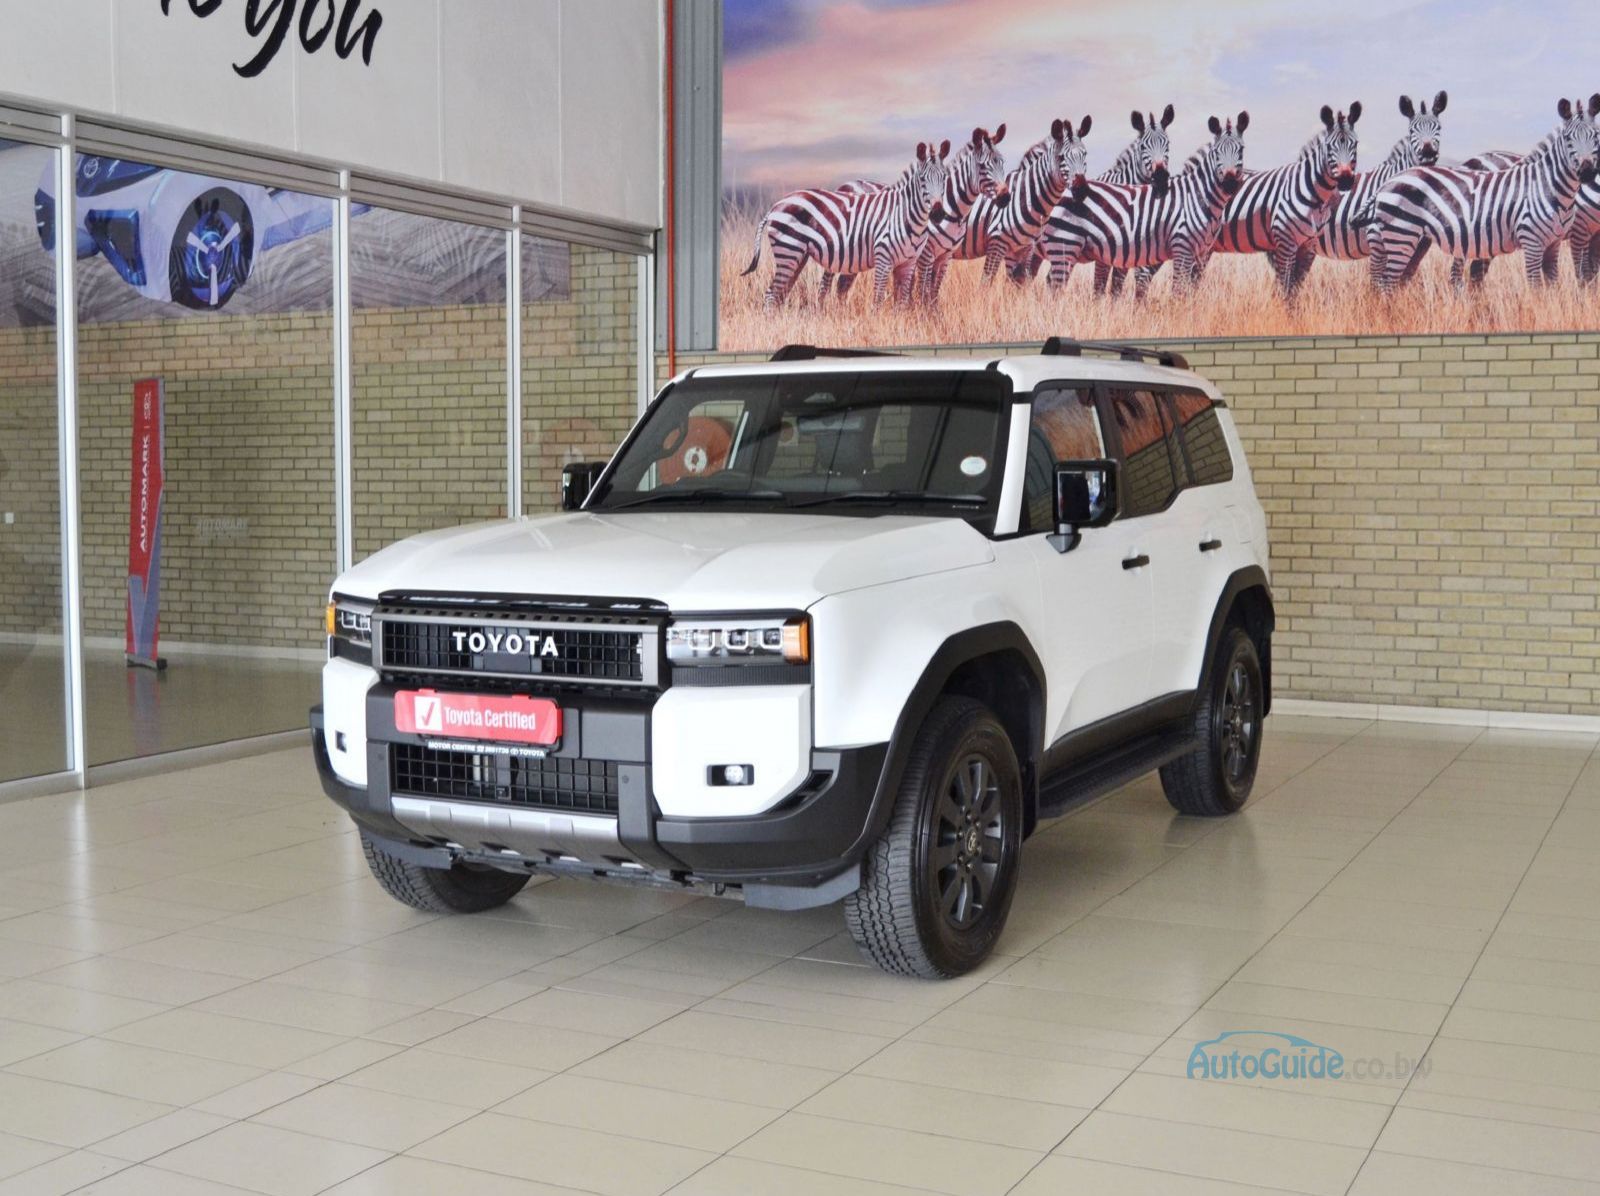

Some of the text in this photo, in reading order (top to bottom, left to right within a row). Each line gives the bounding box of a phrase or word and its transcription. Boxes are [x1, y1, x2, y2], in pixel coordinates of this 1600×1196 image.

[232, 0, 383, 78] you
[140, 435, 150, 552] AUTOMARK
[452, 631, 559, 657] TOYOTA
[444, 706, 536, 731] Toyota Certified
[428, 741, 451, 751] MOTOR
[451, 743, 476, 753] CENTRE
[519, 748, 545, 758] TOYOTA
